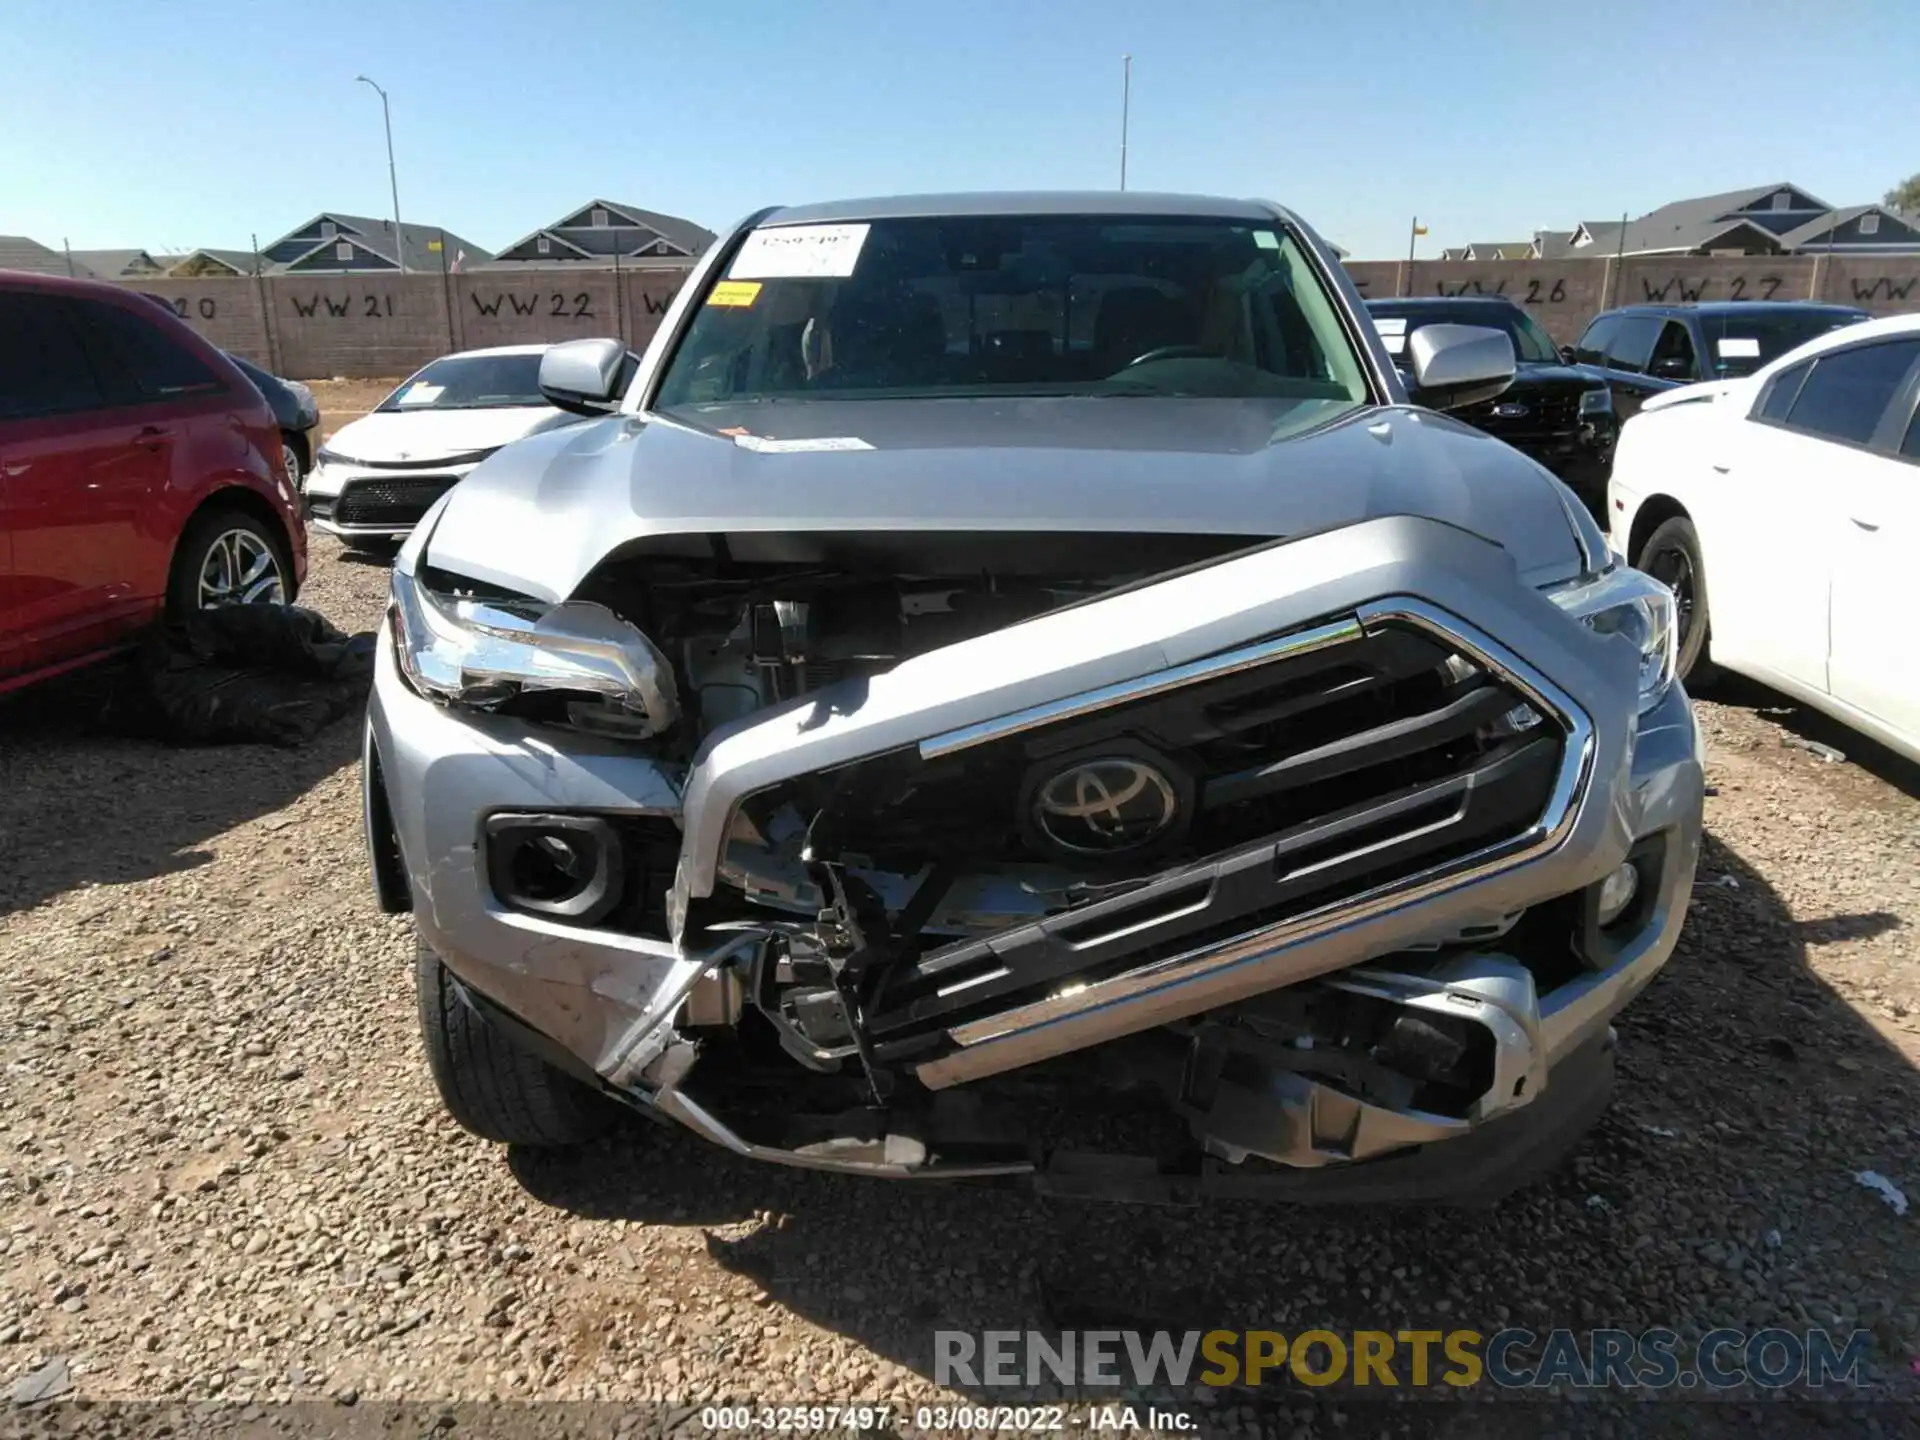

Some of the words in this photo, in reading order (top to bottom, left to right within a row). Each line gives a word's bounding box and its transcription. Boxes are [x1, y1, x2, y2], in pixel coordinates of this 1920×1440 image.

[1524, 277, 1567, 305] 26
[1642, 276, 1711, 302] WW
[1850, 276, 1919, 301] WW
[290, 291, 350, 318] WW
[363, 294, 394, 318] 21
[471, 292, 539, 317] WW
[549, 292, 597, 319] 22
